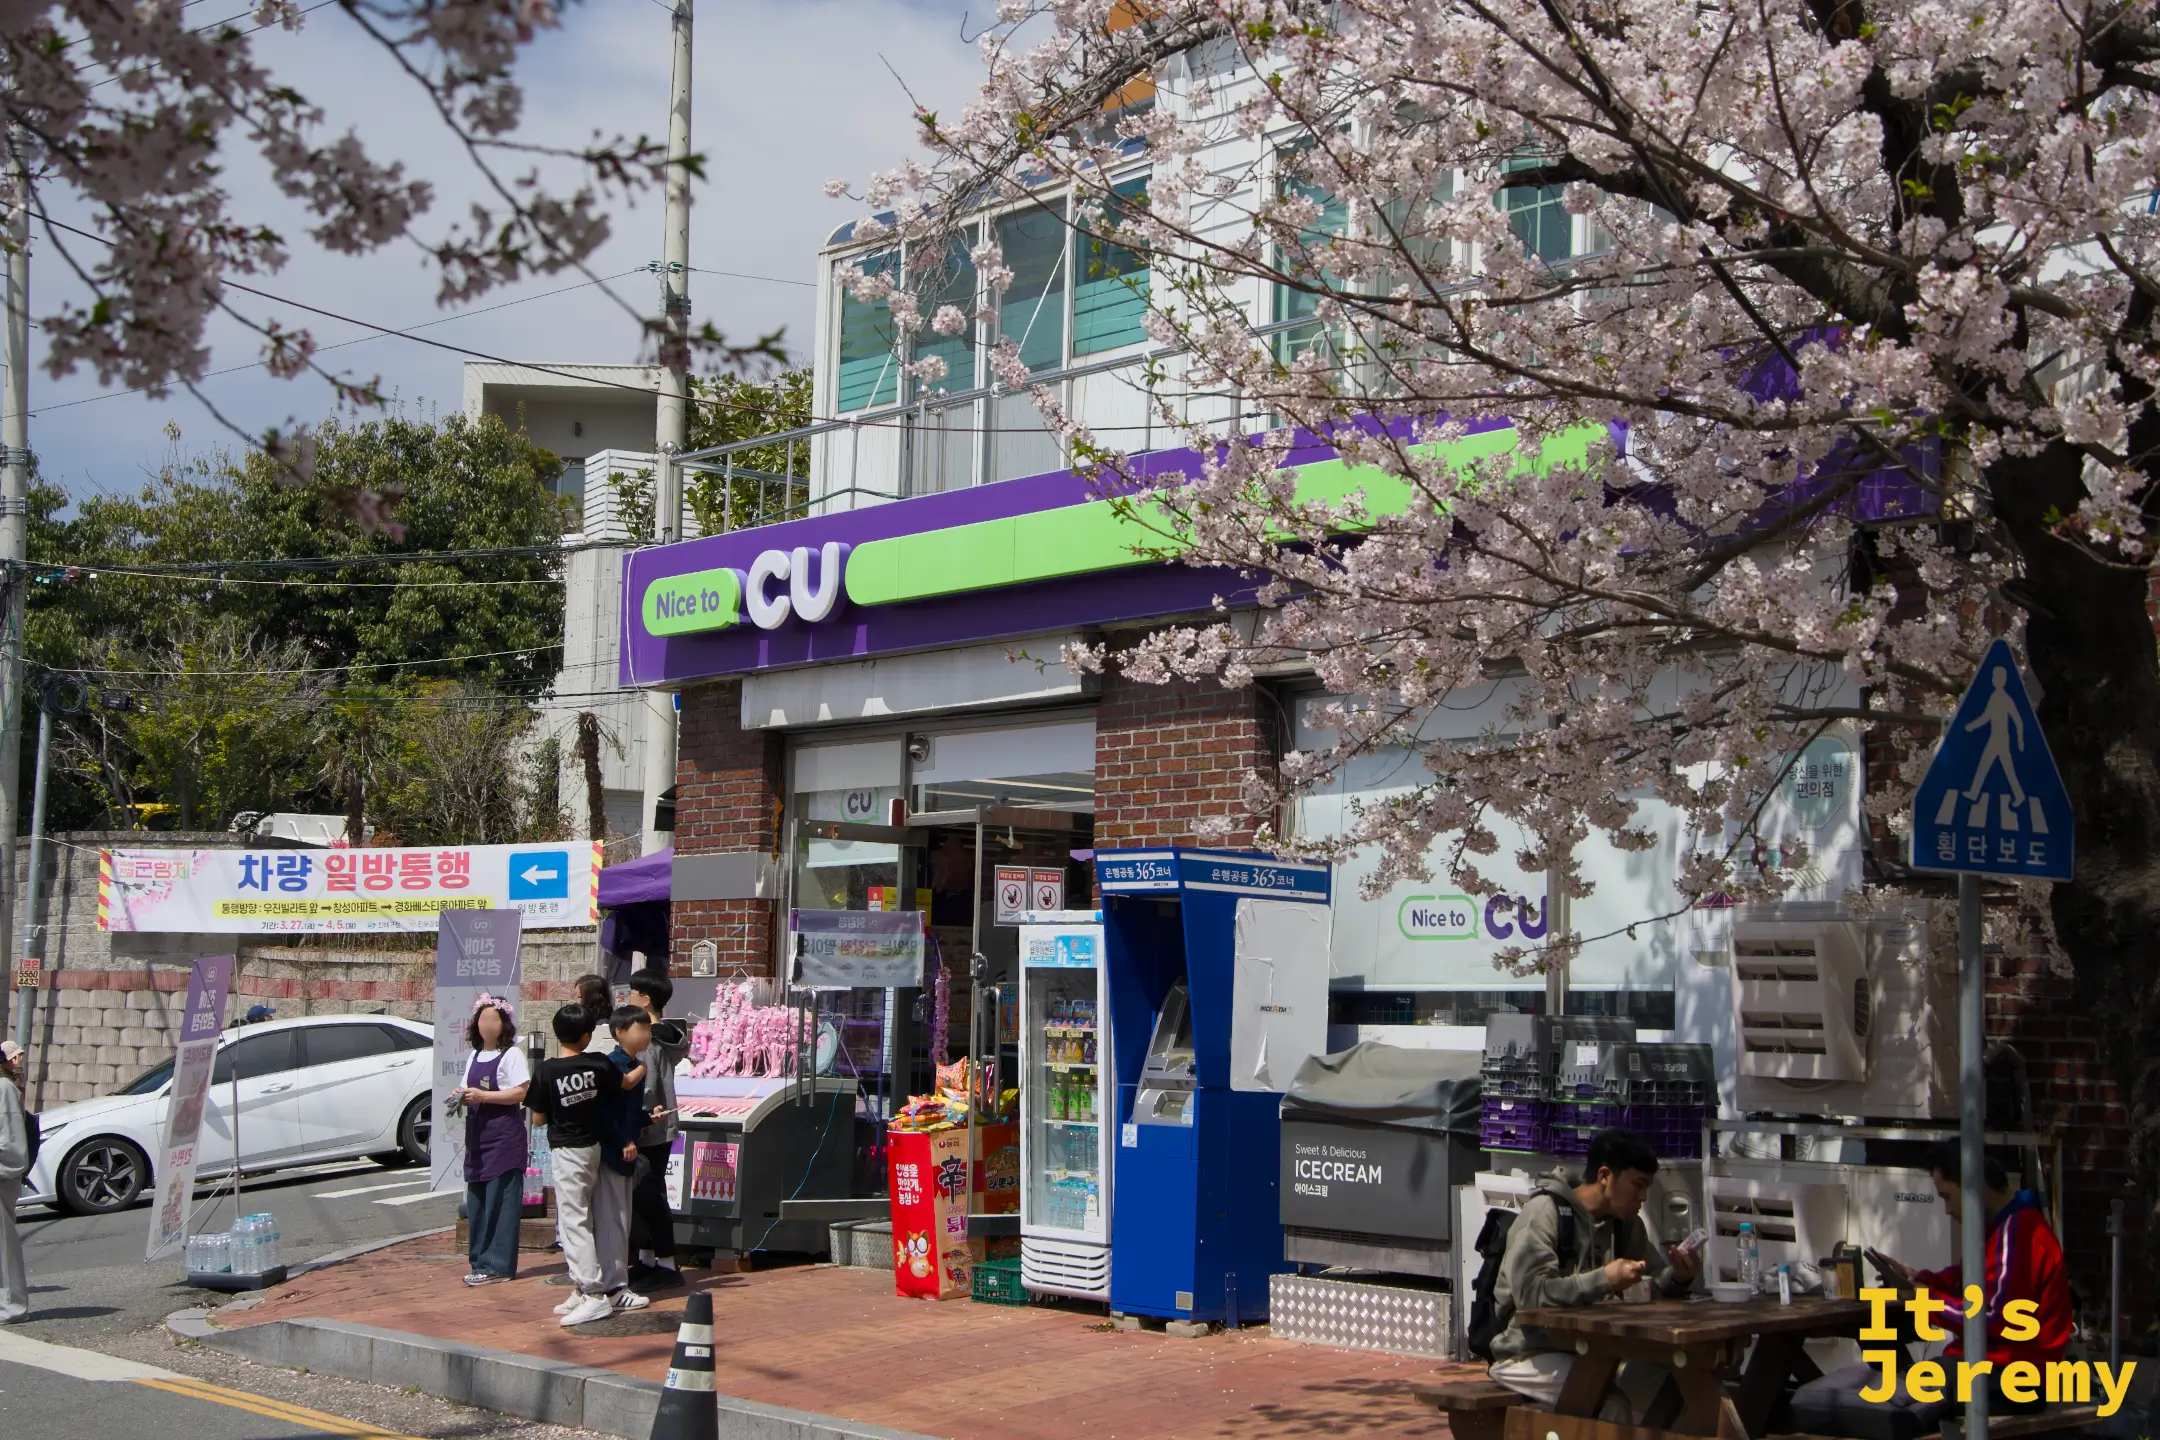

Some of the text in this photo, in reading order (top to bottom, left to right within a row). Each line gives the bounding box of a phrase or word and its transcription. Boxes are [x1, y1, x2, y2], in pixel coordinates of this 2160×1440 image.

[656, 541, 841, 630] Nice to CU
[1789, 763, 1844, 780] 당신을 위한
[1797, 781, 1834, 799] 편의점
[847, 791, 872, 814] CU
[1936, 831, 2047, 865] 횡단보도
[135, 861, 190, 879] 군항제
[238, 851, 470, 892] 차량 일방통행
[1105, 865, 1134, 879] 은행공동
[1211, 868, 1249, 883] 은행공동
[221, 903, 258, 914] 통행방향
[263, 903, 308, 914] 우진빌라트
[310, 903, 318, 914] 앞
[333, 901, 378, 913] 창성아파트
[517, 901, 560, 915] 일방통행
[1412, 894, 1548, 940] Nice to CU
[19, 970, 39, 978] 5560
[699, 959, 708, 973] 4
[18, 978, 39, 986] 4433
[556, 1070, 596, 1095] KOR
[697, 1148, 735, 1164] 아이스크림
[1295, 1143, 1367, 1159] Sweet & Delicious
[896, 1163, 918, 1178] 인생을
[1295, 1159, 1382, 1185] ICECREAM
[897, 1178, 923, 1193] 맛있게,
[938, 1154, 968, 1205] 辛
[1294, 1182, 1329, 1197] 아이스크림
[899, 1191, 912, 1205] 농심
